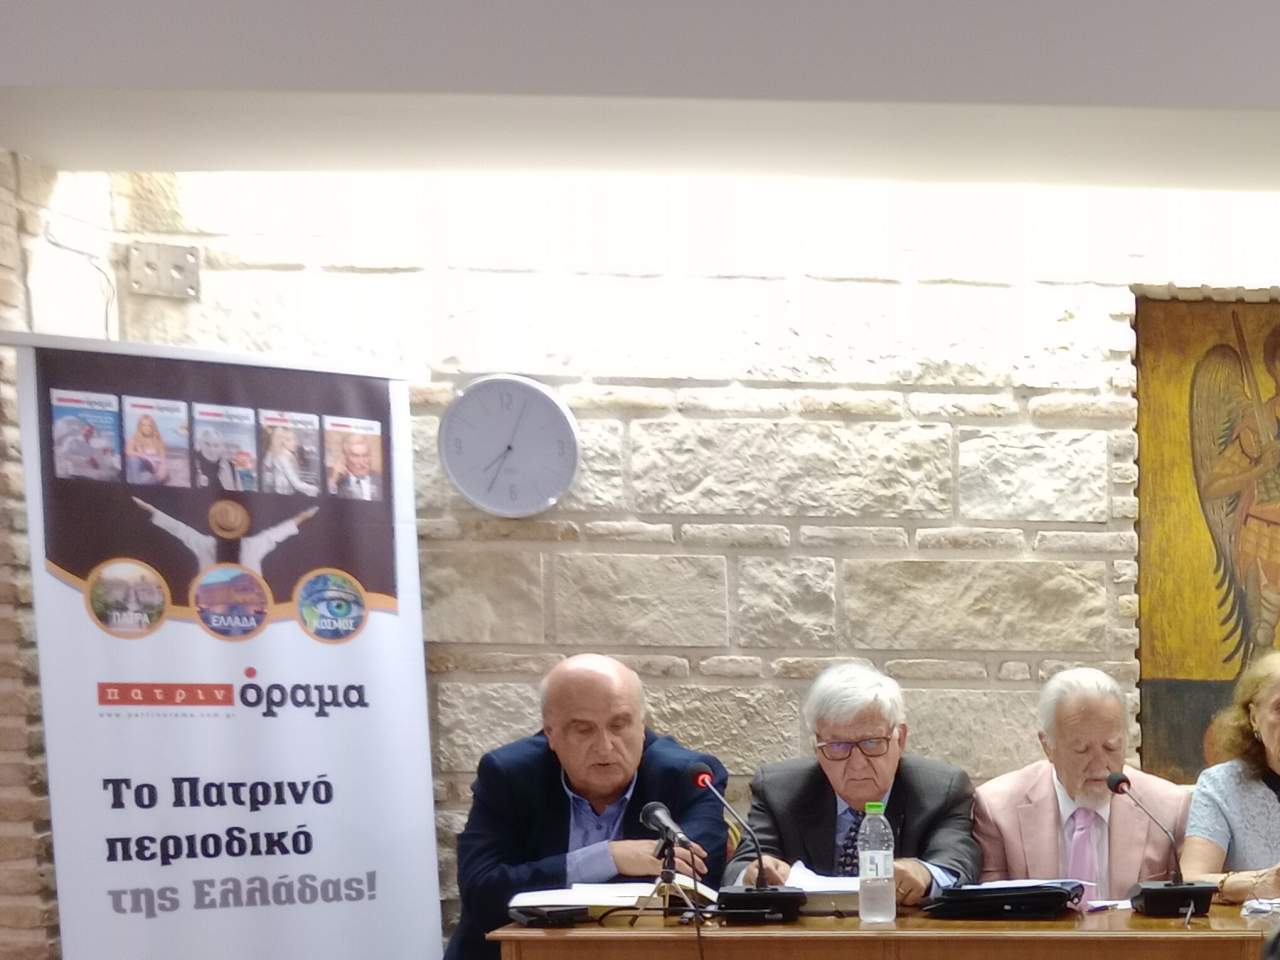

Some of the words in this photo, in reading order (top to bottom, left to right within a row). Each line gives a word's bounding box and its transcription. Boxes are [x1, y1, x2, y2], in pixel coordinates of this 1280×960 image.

[210, 614, 257, 628] ΕΛΛΑΔΑ
[313, 617, 356, 631] ΚΟΣΜΟΣ
[102, 778, 158, 809] Το
[172, 774, 334, 812] Πατρινό
[105, 824, 313, 866] περιοδικό
[107, 886, 180, 919] της
[193, 870, 377, 909] Ελλάδας!
